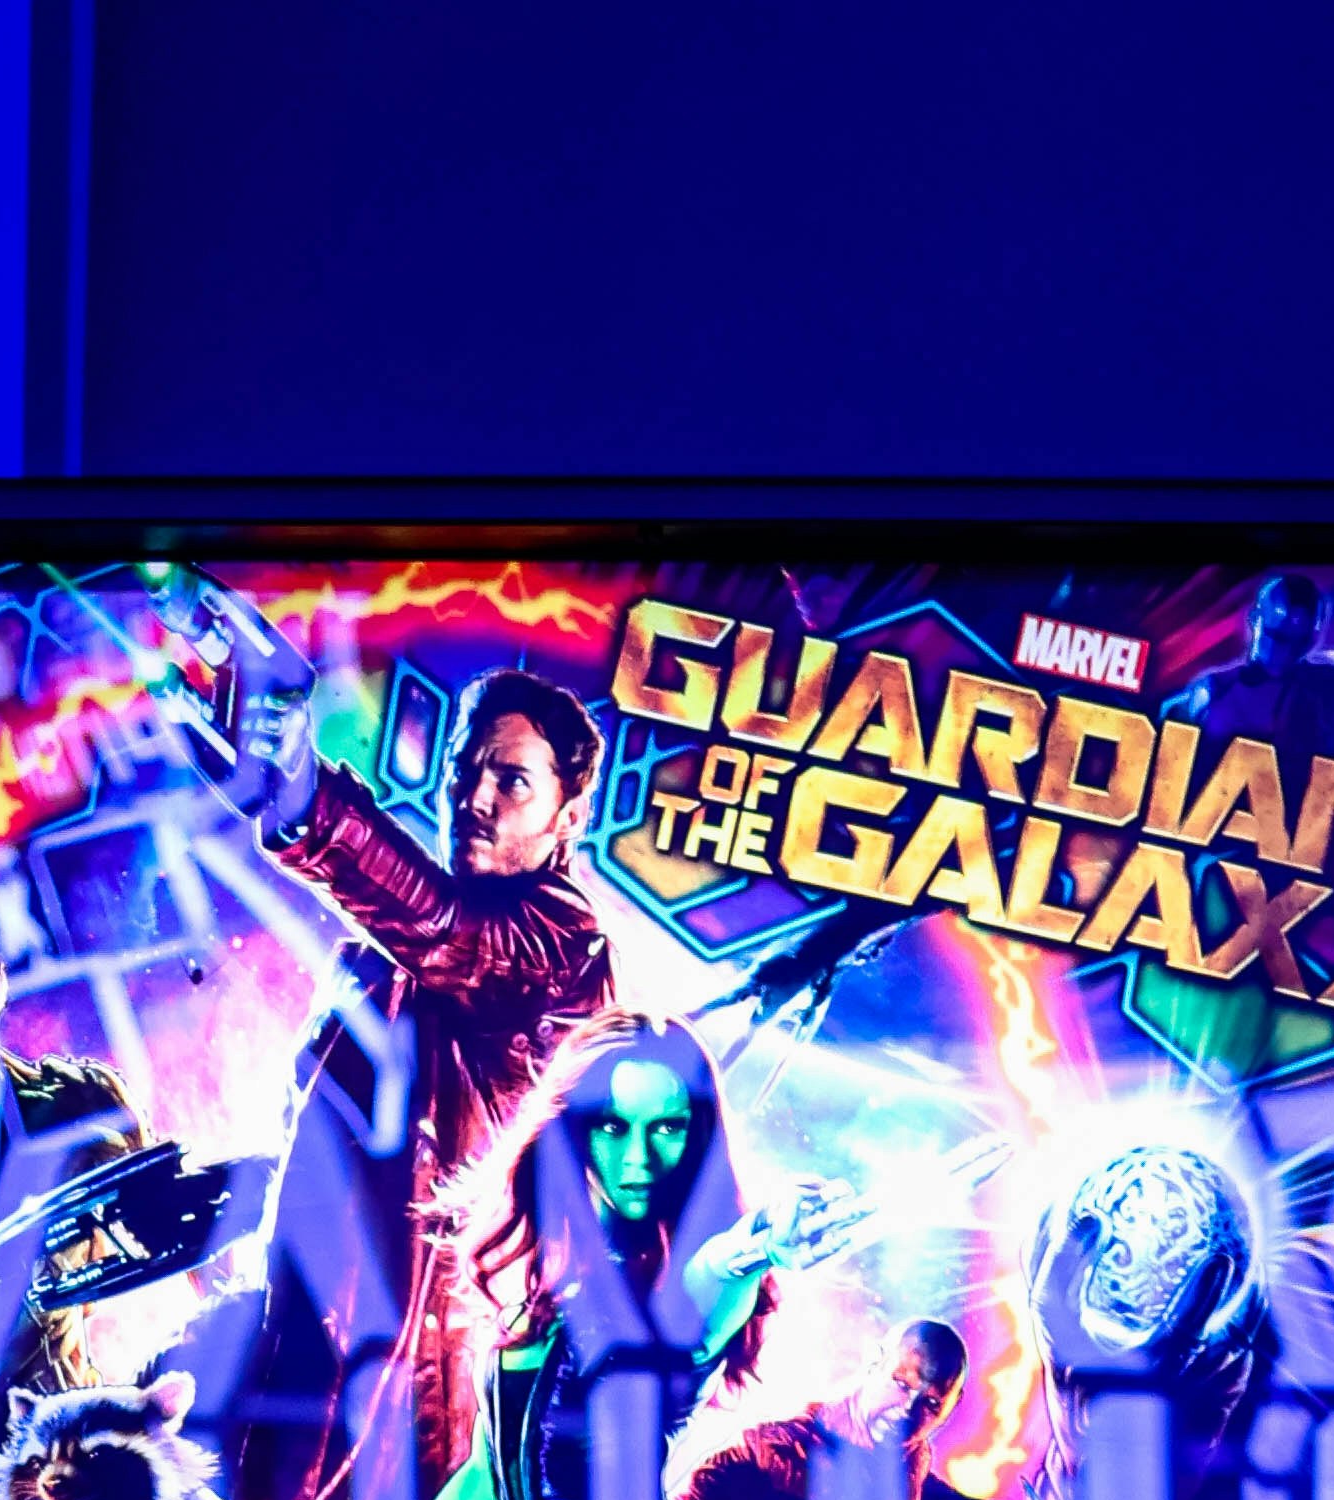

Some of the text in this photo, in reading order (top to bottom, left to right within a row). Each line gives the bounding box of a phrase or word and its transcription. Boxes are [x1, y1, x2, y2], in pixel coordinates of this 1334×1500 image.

[1015, 614, 1144, 690] MARVEL
[697, 742, 791, 811] OF
[652, 793, 773, 876] THE
